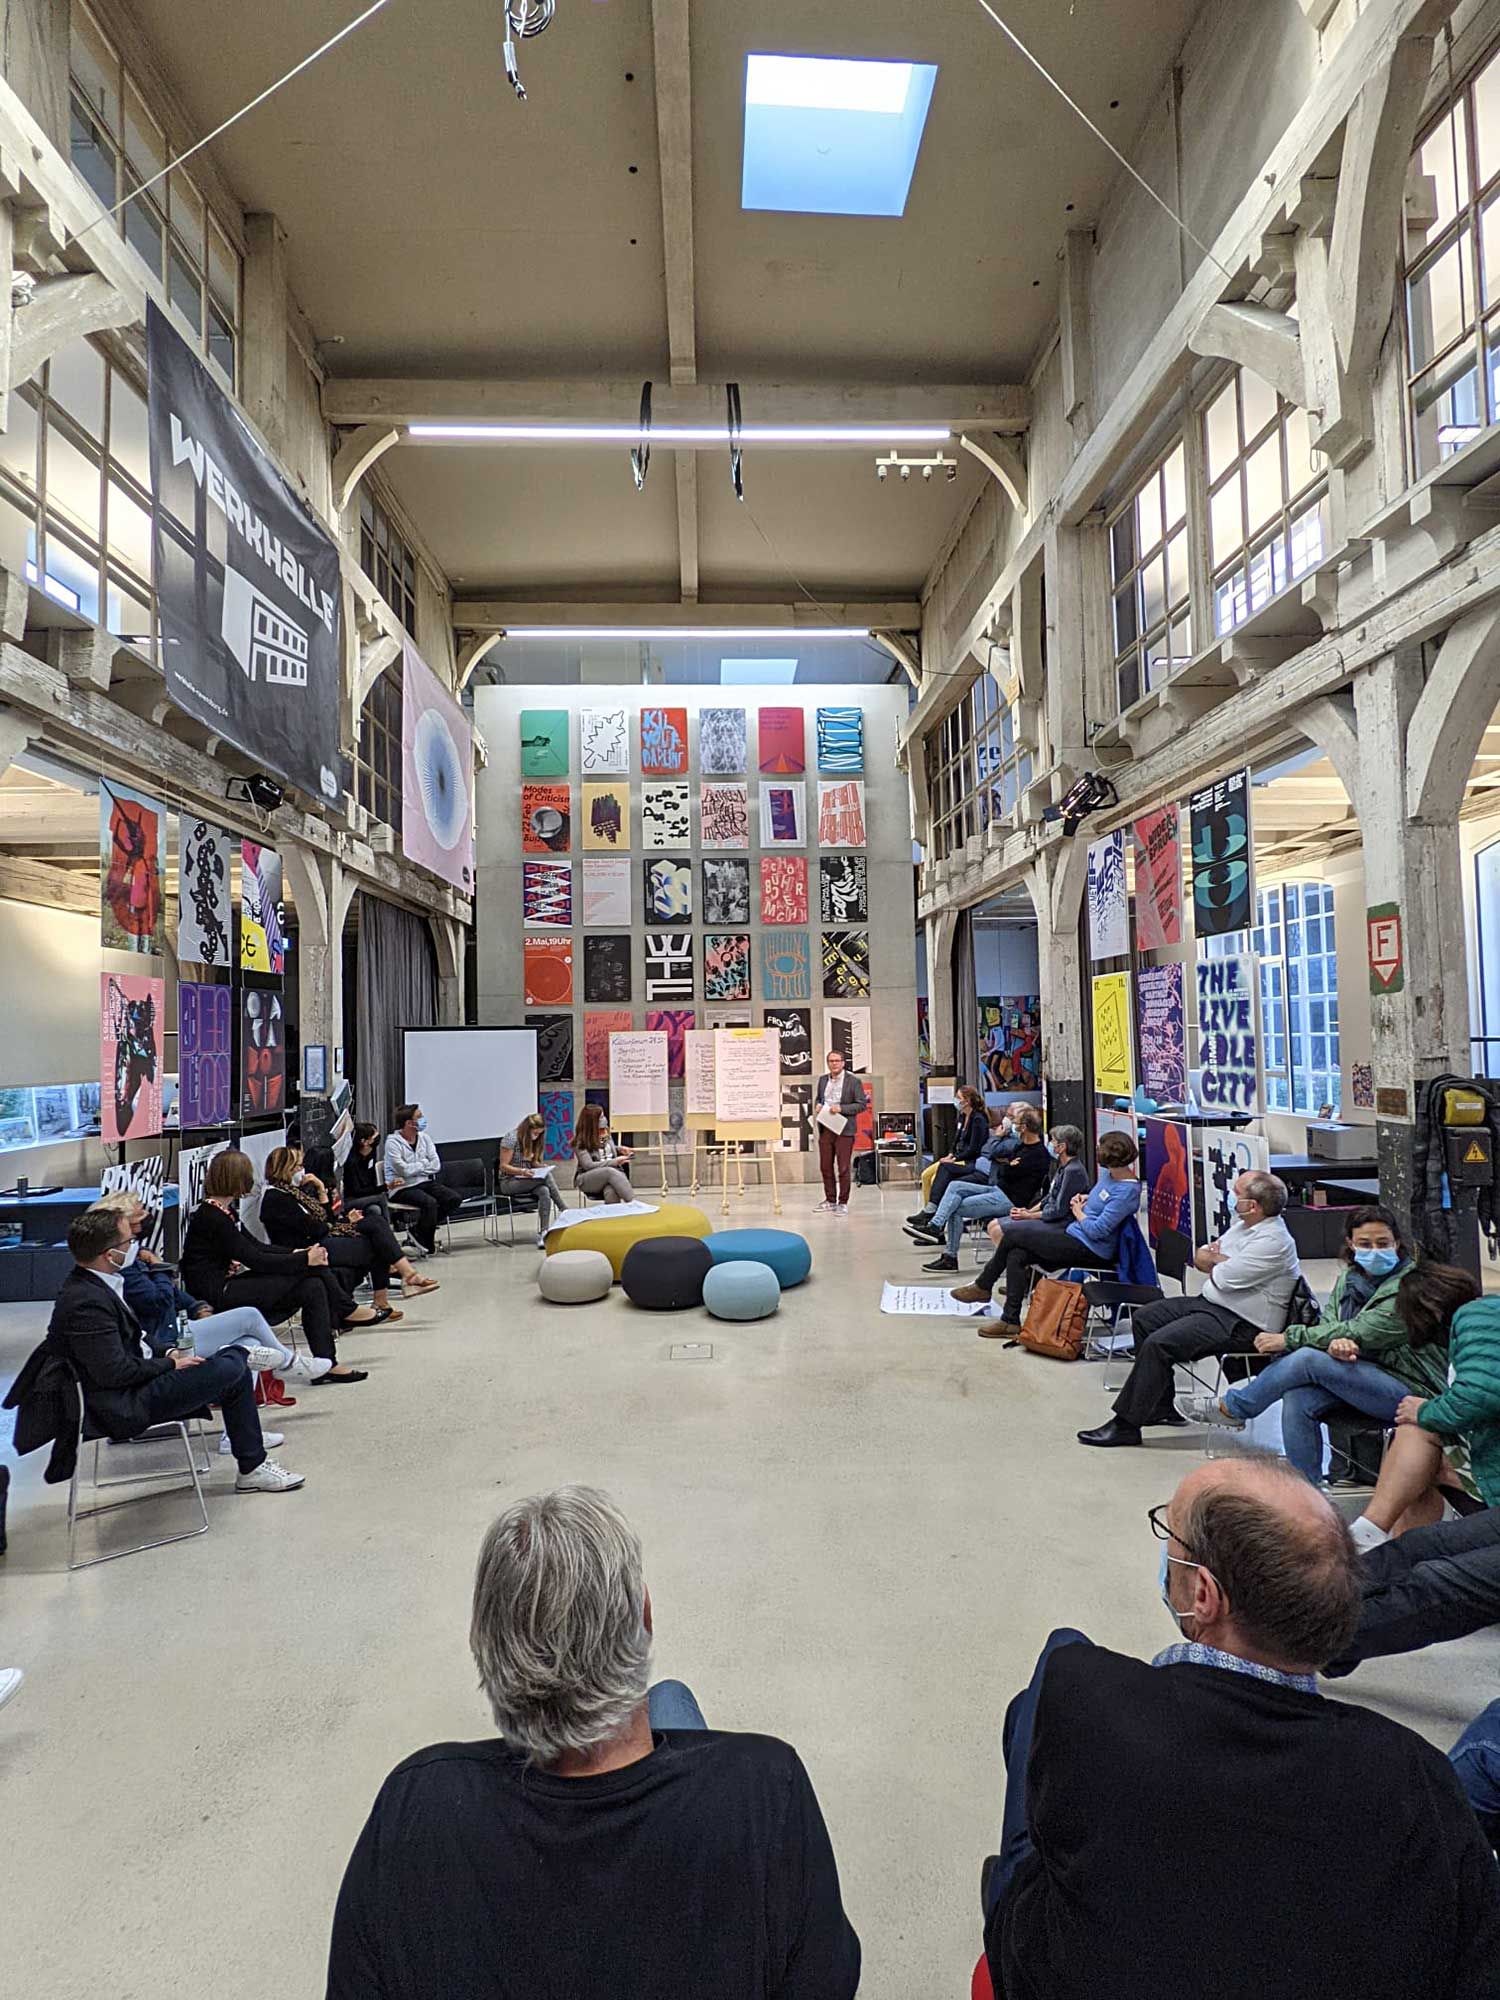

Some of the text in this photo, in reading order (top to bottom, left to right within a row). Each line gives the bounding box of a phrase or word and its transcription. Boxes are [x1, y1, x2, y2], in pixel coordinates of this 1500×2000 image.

[523, 793, 534, 801] of
[524, 785, 552, 794] Modes
[1377, 924, 1392, 957] F
[1197, 960, 1239, 995] THE
[1199, 999, 1250, 1033] LIVE
[1201, 1069, 1257, 1107] CITY
